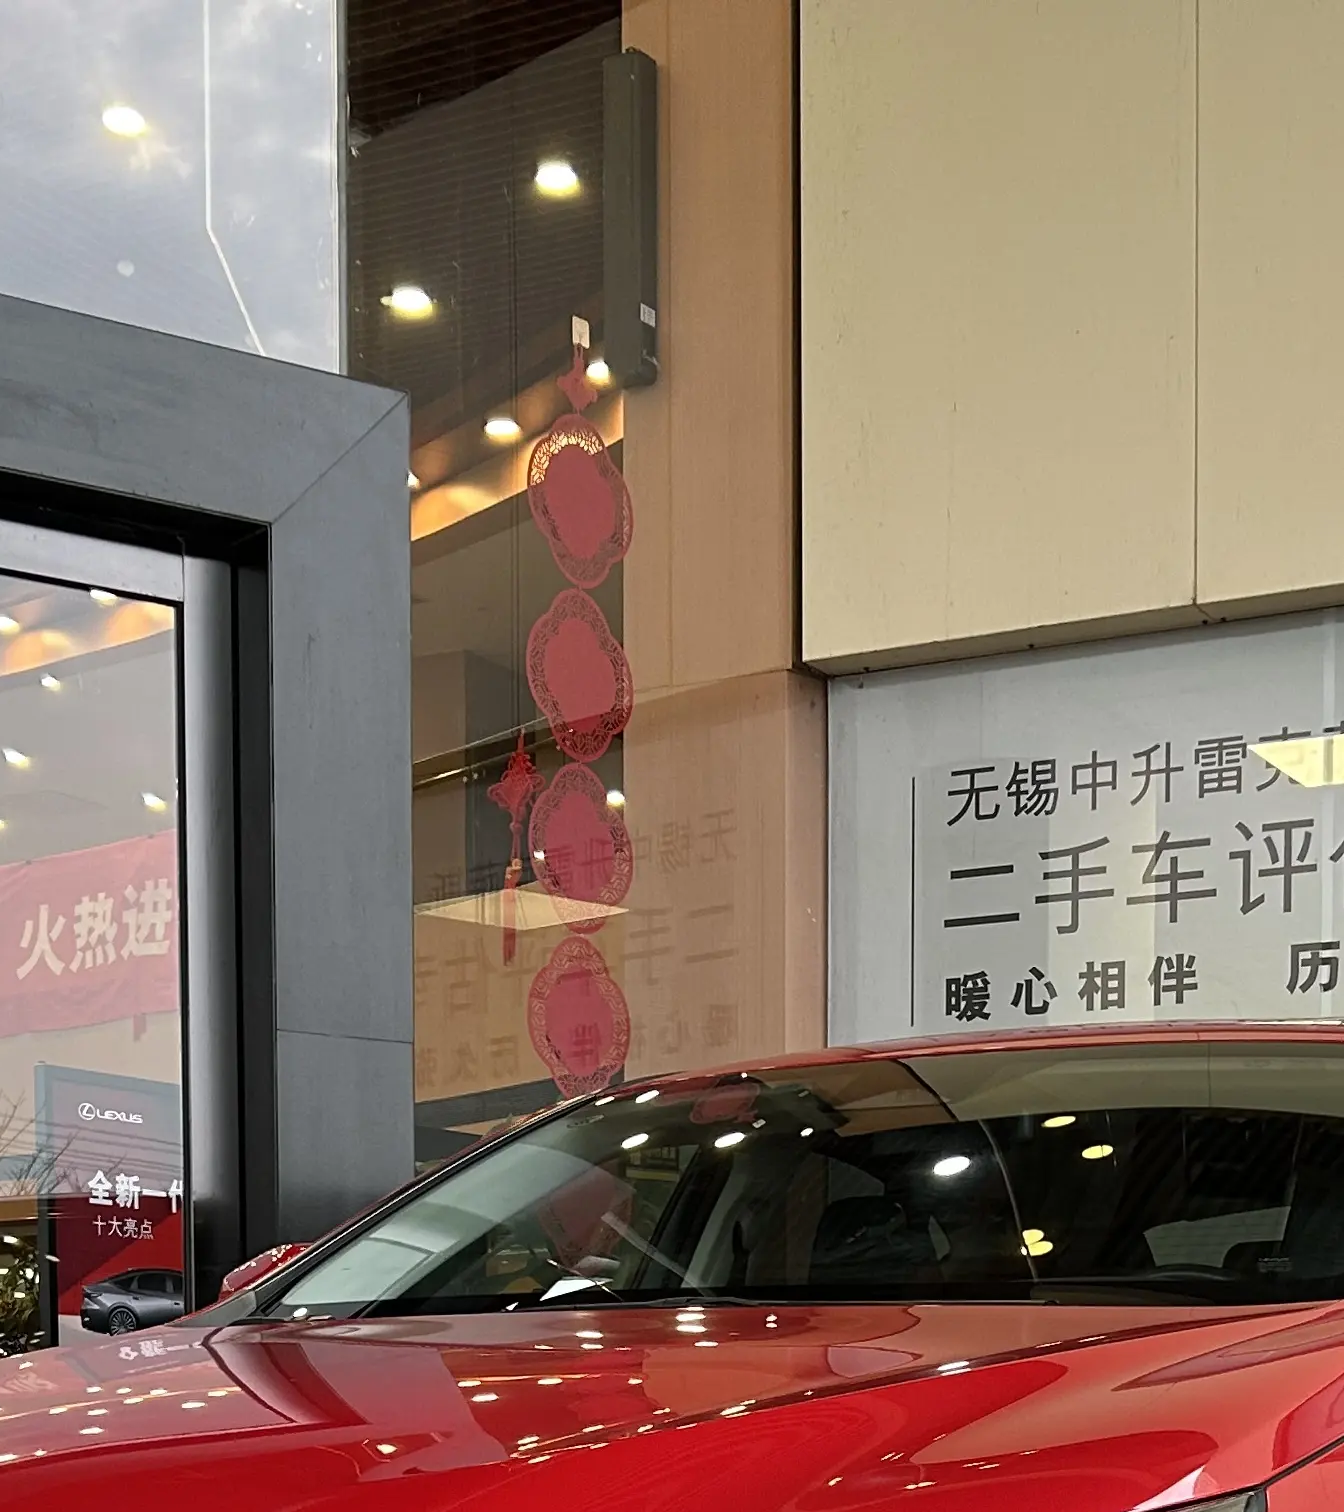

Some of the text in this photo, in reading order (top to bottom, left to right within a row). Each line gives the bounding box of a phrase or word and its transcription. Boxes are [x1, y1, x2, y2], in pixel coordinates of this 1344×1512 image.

[944, 951, 1199, 1022] 暖心相伴
[96, 1108, 144, 1124] LEXUS
[92, 1214, 155, 1241] 十大亮点
